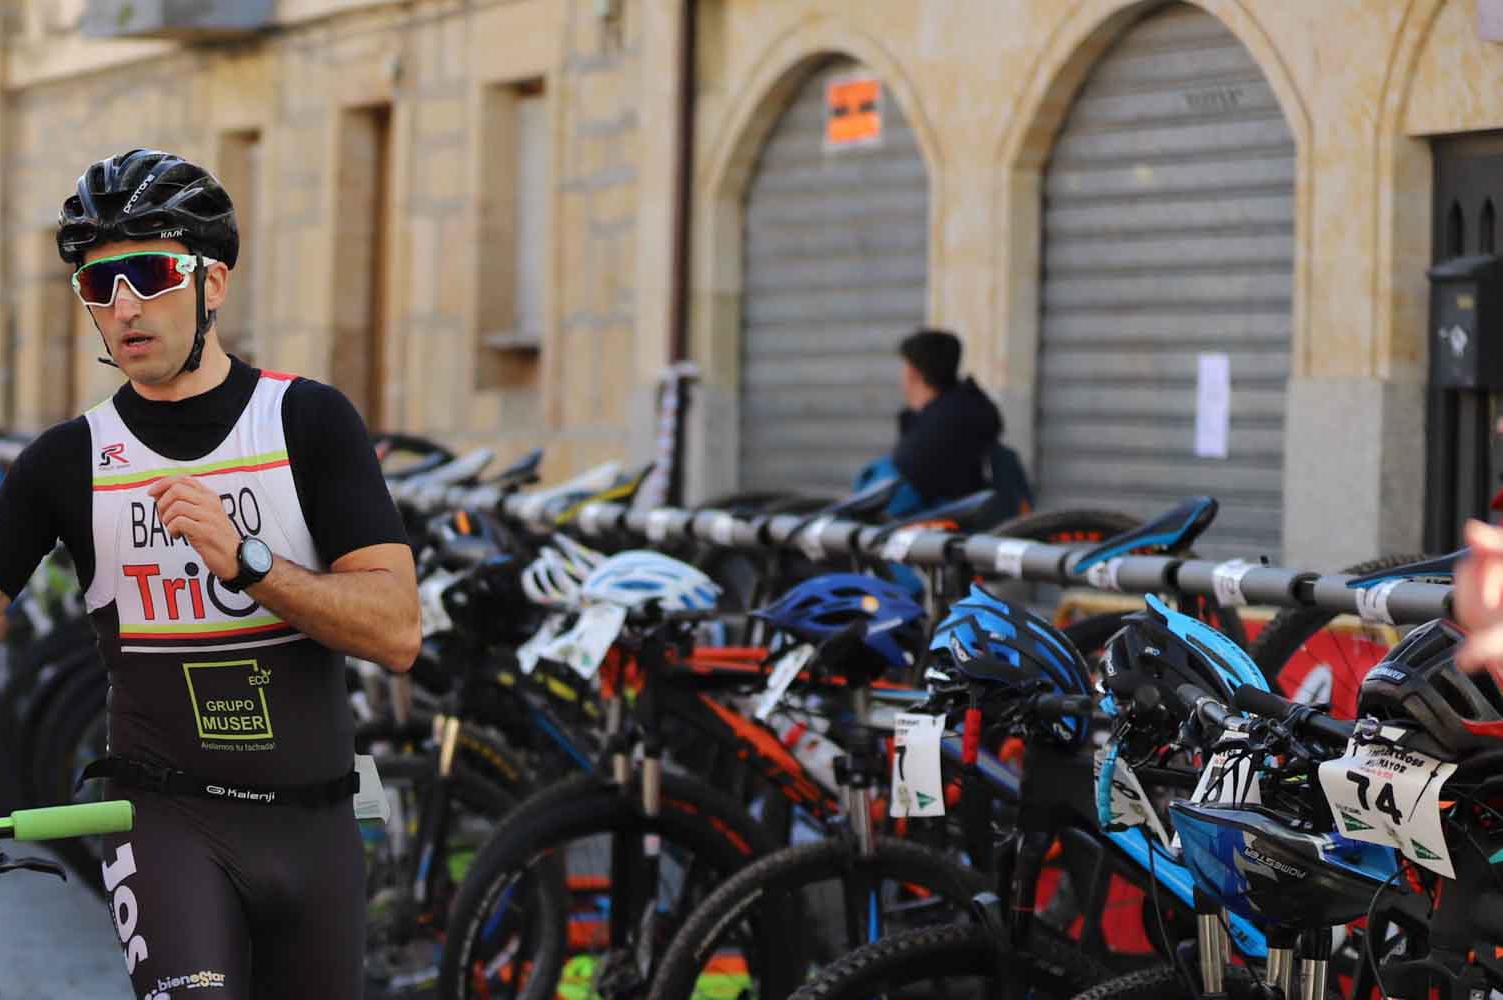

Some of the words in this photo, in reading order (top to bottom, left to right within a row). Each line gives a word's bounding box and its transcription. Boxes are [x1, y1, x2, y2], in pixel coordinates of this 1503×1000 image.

[131, 487, 262, 549] BARO
[122, 561, 261, 620] TriO
[249, 675, 271, 686] ECO
[206, 700, 254, 712] GRUPO
[203, 715, 265, 731] MUSER
[227, 789, 275, 802] Kalenji
[1346, 770, 1403, 825] 74
